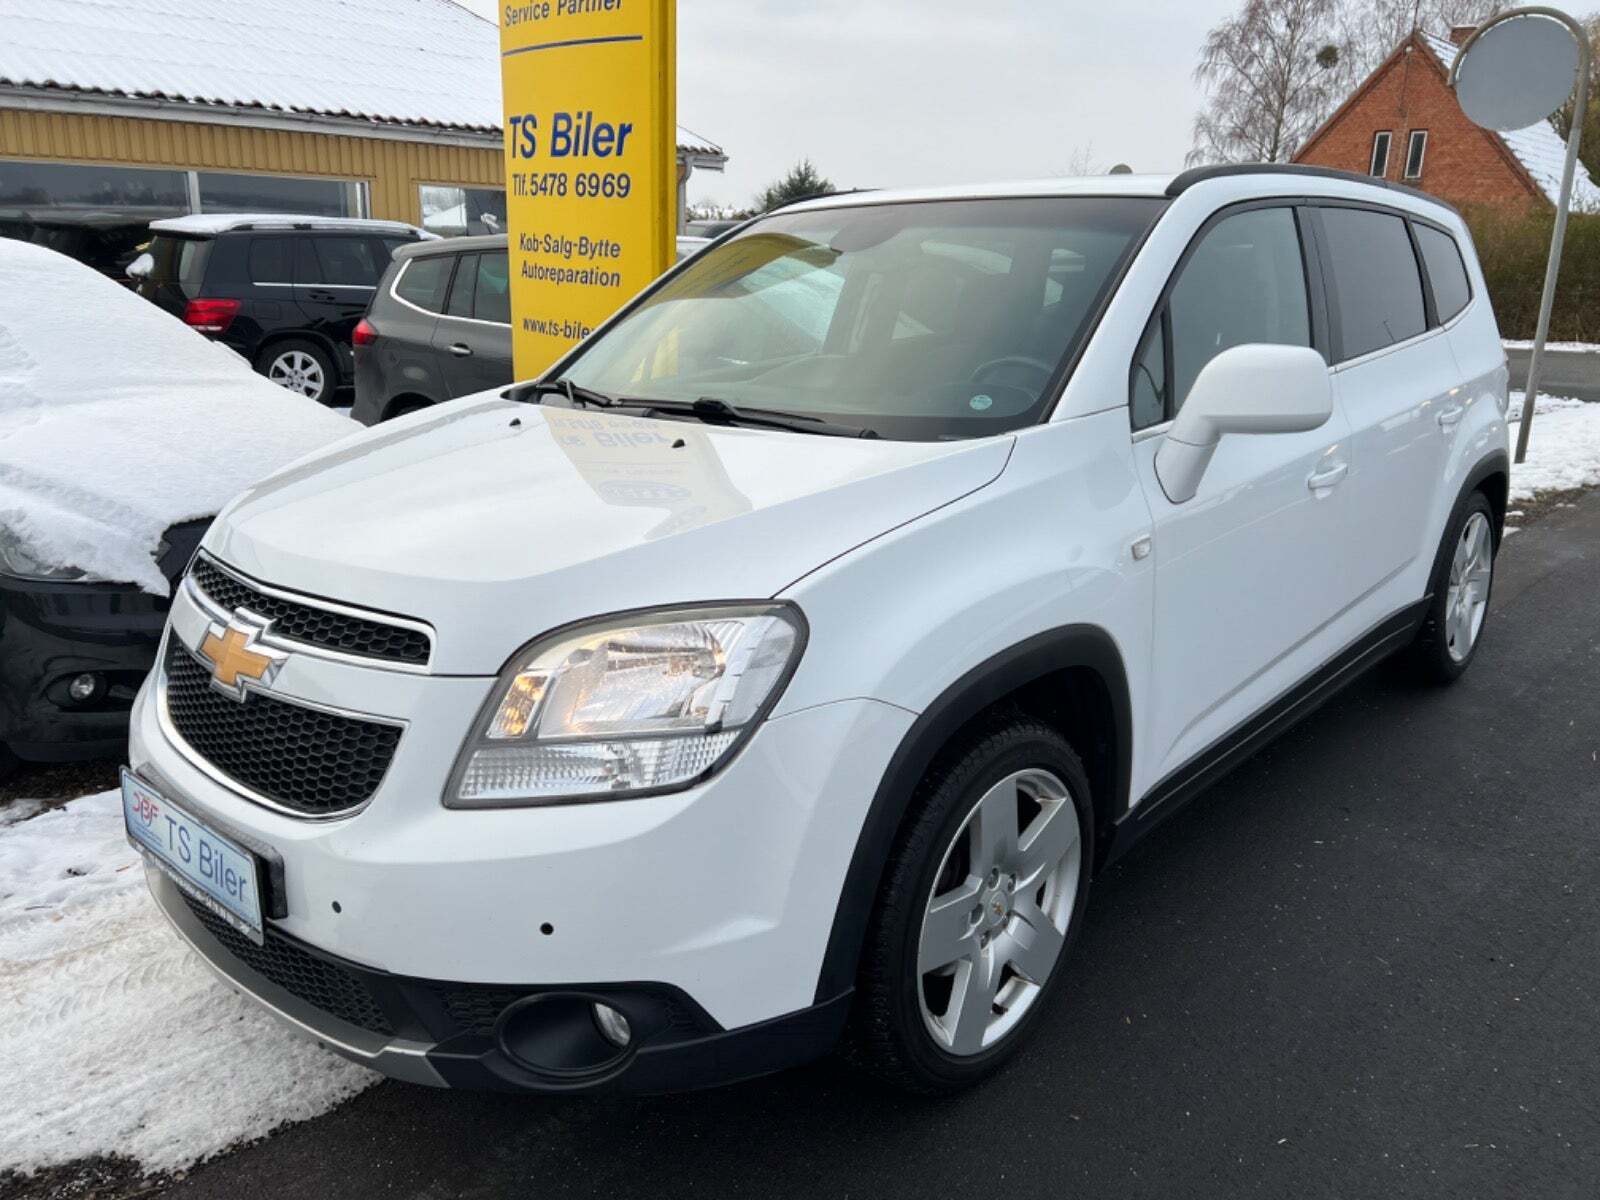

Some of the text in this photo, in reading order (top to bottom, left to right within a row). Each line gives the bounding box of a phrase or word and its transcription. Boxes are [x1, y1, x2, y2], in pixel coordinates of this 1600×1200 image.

[505, 0, 622, 27] Service Partner
[509, 111, 632, 159] TS Biler
[513, 172, 631, 198] Tlf. 5478 6969
[521, 260, 621, 287] Autoreparation
[523, 317, 594, 339] www.ts-bile
[164, 814, 191, 864] TS
[199, 838, 247, 901] Biler
